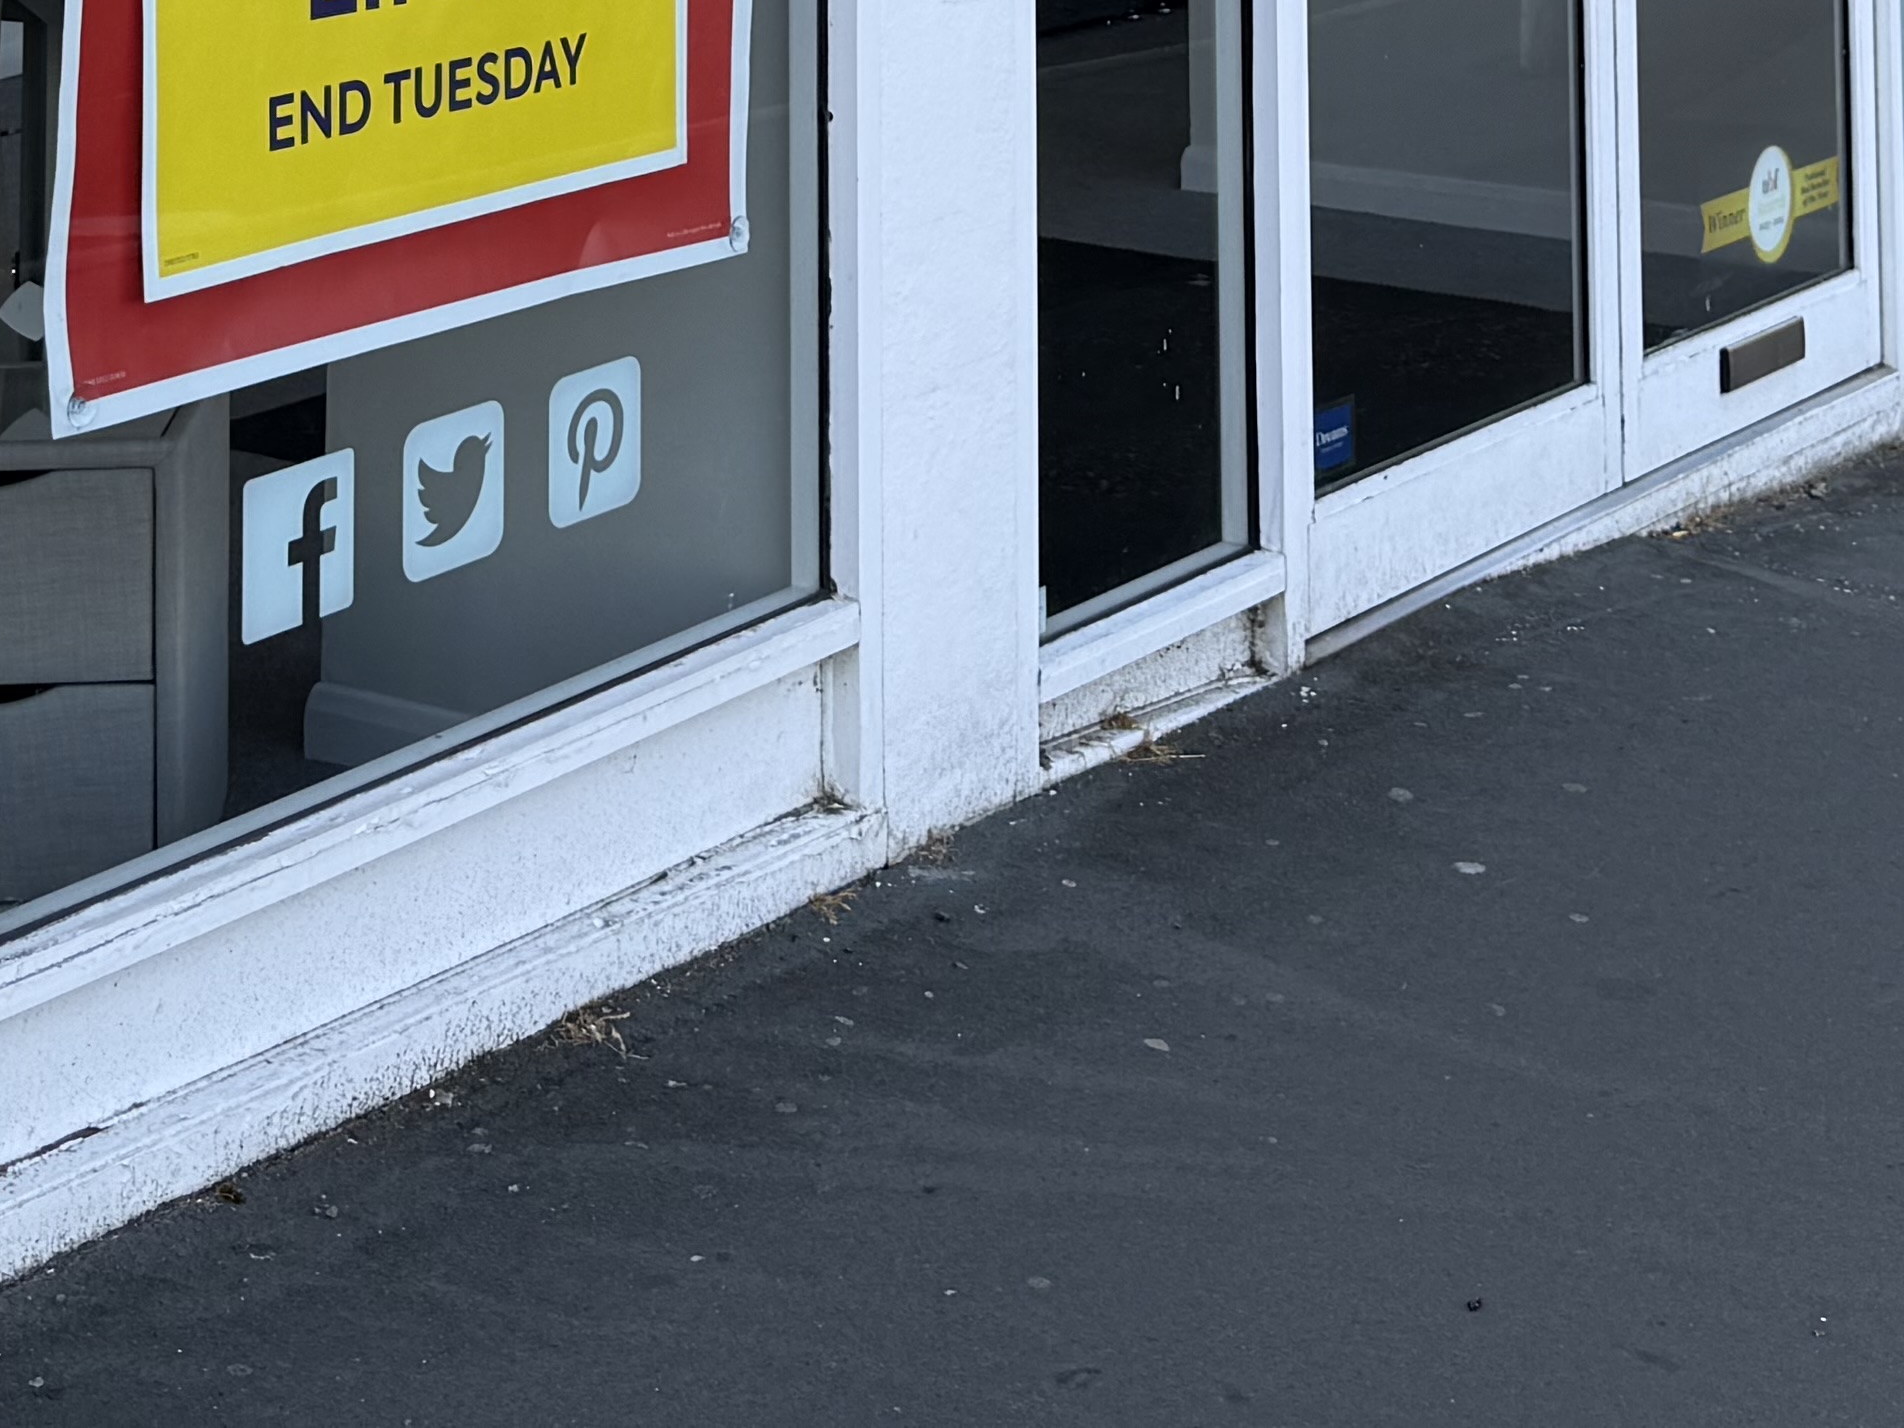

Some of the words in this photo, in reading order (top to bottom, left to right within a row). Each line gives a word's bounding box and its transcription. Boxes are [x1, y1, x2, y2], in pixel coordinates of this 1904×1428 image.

[268, 82, 371, 151] END
[384, 32, 588, 125] TUESDAY
[1708, 208, 1747, 234] Winner
